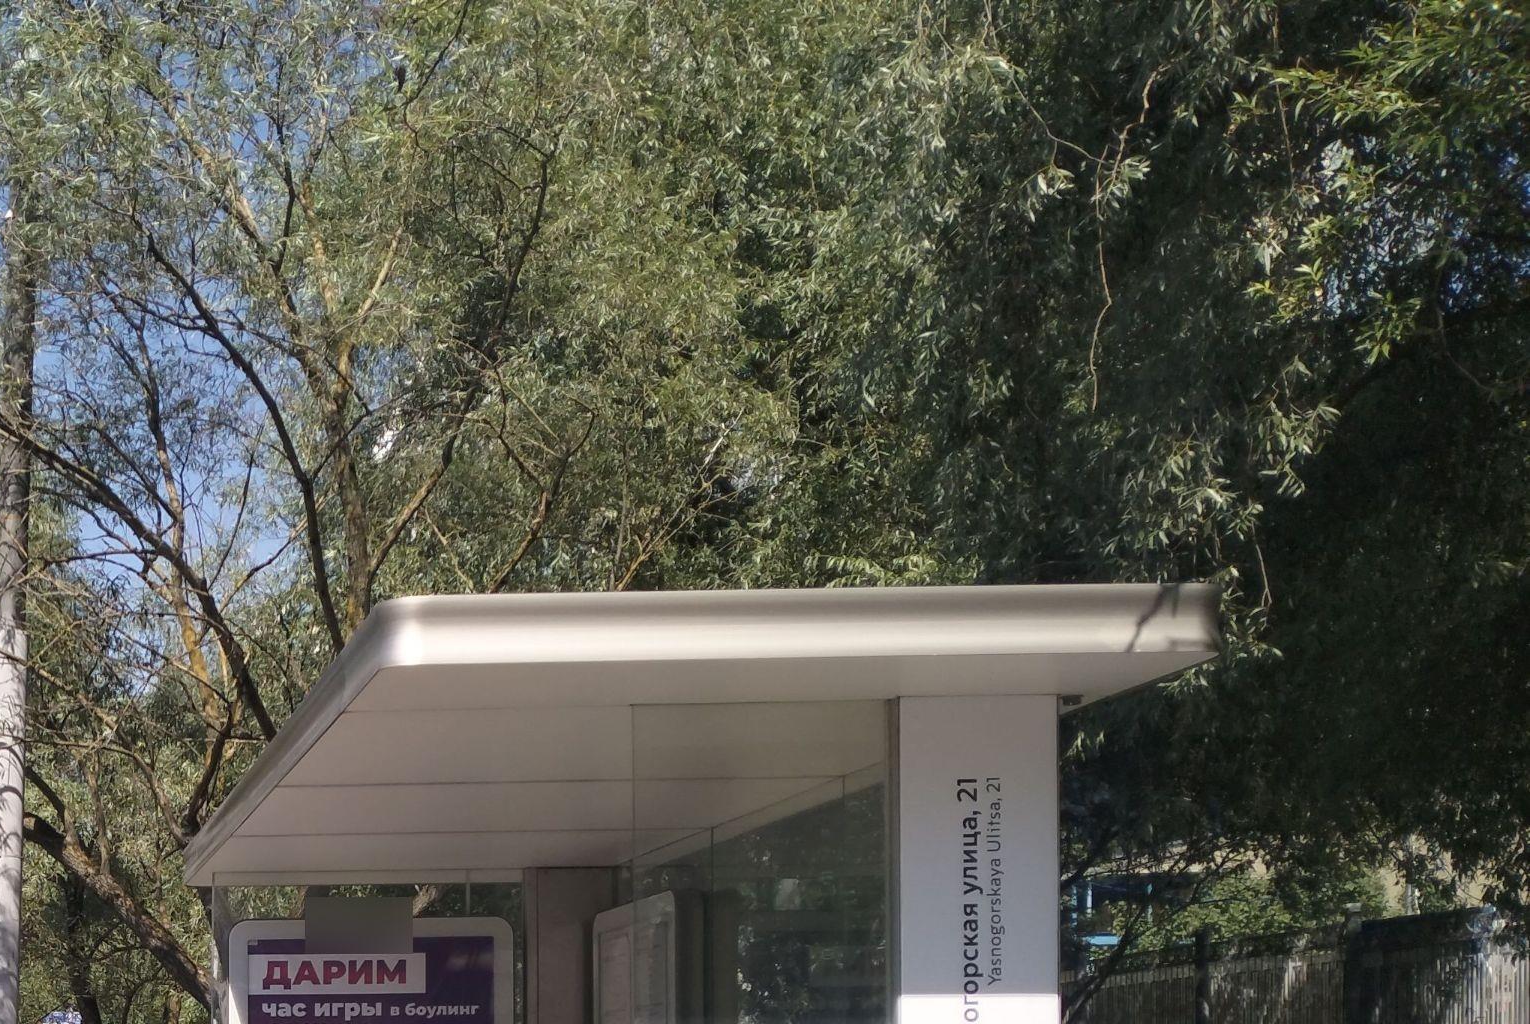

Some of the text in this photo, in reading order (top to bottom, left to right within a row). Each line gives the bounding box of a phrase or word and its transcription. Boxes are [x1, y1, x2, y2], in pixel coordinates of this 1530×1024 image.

[956, 778, 978, 802] 21
[962, 810, 983, 895] улица,
[986, 777, 1005, 987] Yasnogorskaya Ulitsa, 21
[262, 959, 407, 990] ДАРИМ
[261, 1002, 480, 1021] час игры в боулинг
